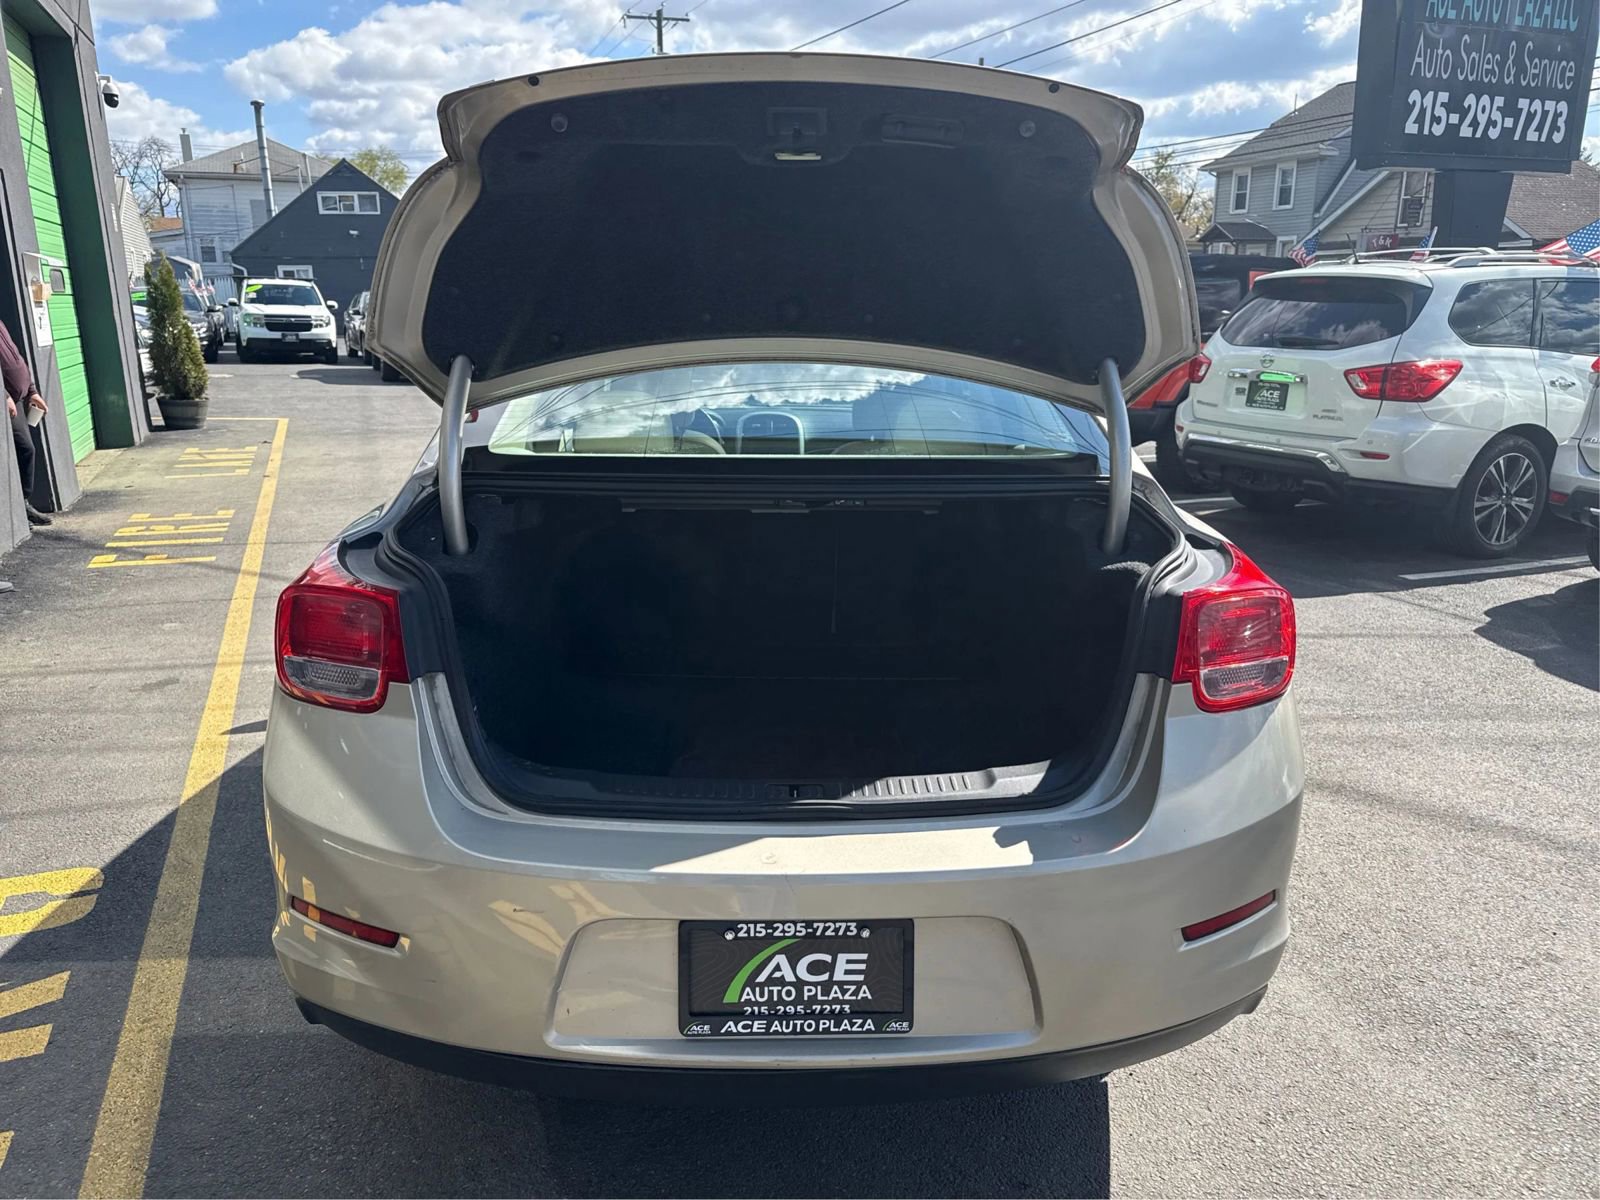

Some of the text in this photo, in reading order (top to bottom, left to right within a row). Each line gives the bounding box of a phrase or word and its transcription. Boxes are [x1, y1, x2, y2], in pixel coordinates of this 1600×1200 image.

[1410, 31, 1576, 90] Auto Sales & Service
[1404, 89, 1569, 144] 215-295-7273
[1260, 390, 1280, 398] ACE
[737, 922, 857, 938] 215-295-7273
[755, 953, 869, 983] ACE
[740, 985, 872, 1002] AUTO PLAZA
[743, 1004, 850, 1016] 215-295-7273
[720, 1018, 875, 1034] ACE AUTO PLAZA
